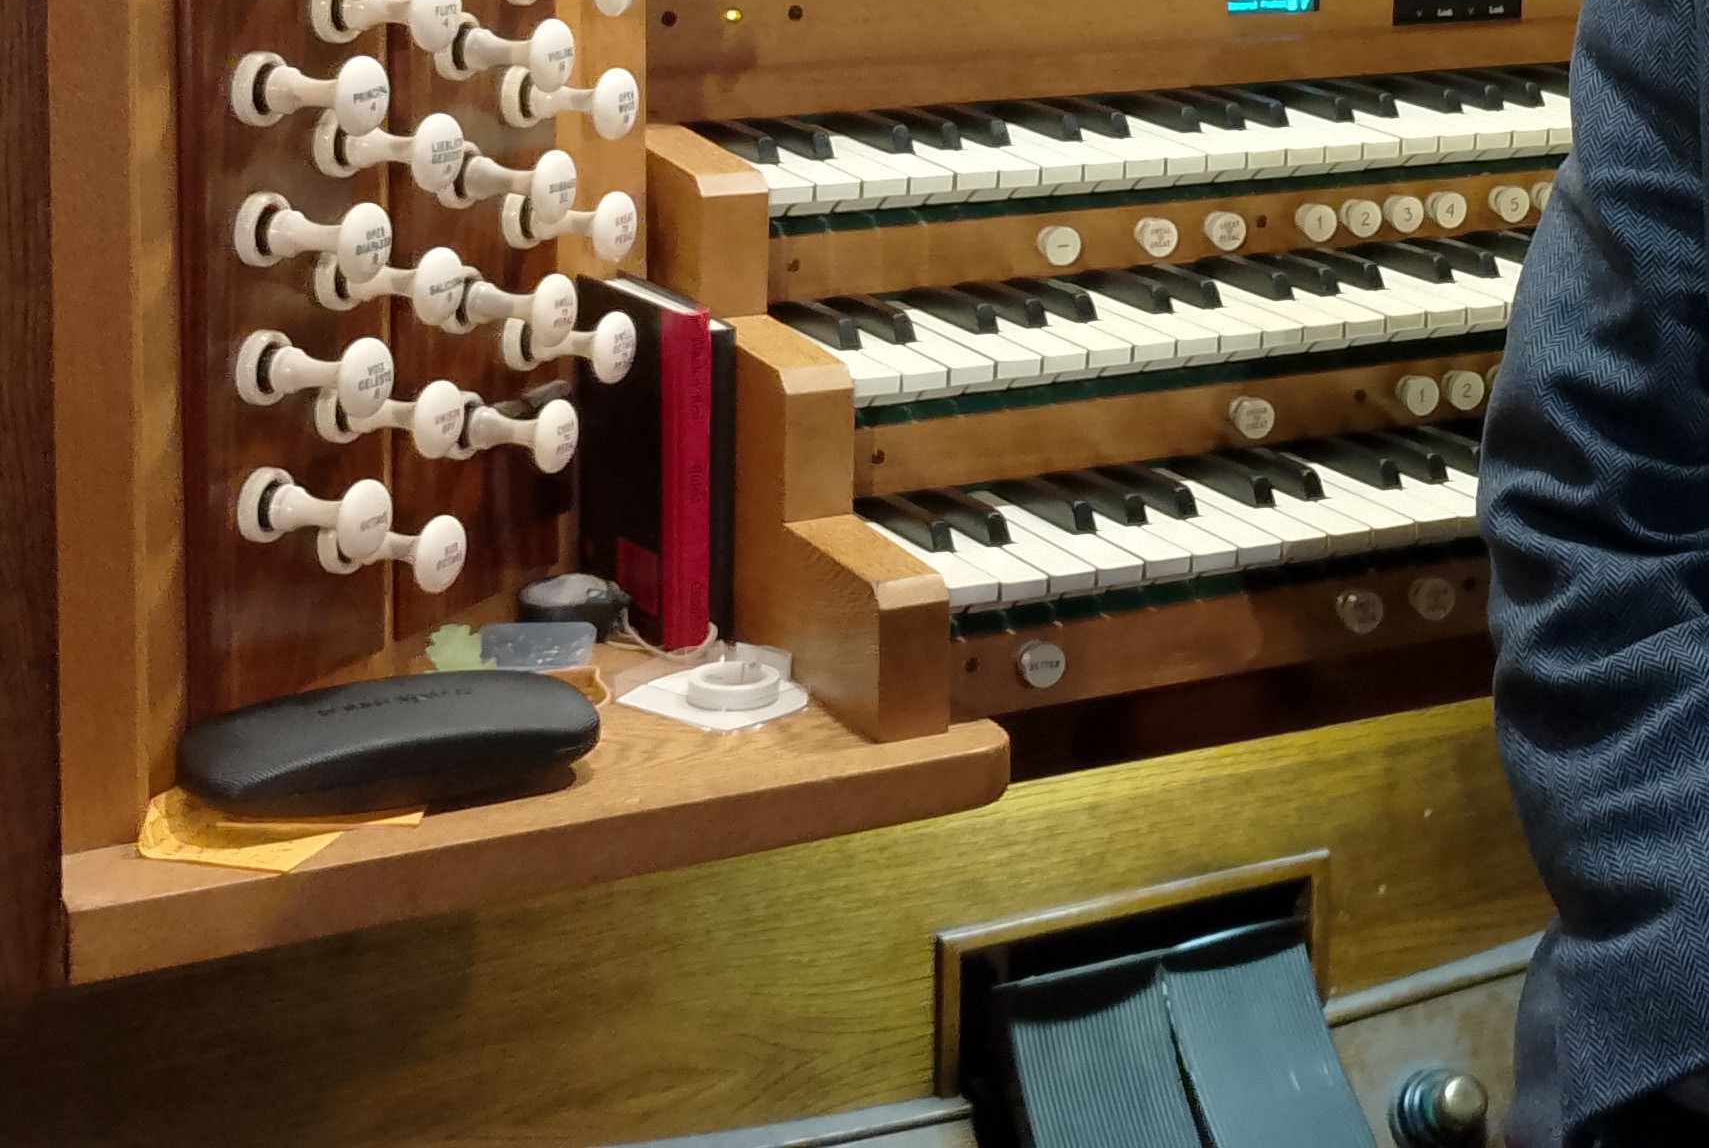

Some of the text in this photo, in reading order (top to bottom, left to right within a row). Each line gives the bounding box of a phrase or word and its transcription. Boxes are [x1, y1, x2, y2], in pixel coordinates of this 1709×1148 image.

[1445, 203, 1455, 218] 4
[1510, 197, 1519, 212] 5
[1361, 212, 1371, 226] 2
[1403, 207, 1413, 222] 3
[1316, 216, 1323, 229] 1
[1420, 388, 1425, 403] 1
[1462, 383, 1472, 398] 2
